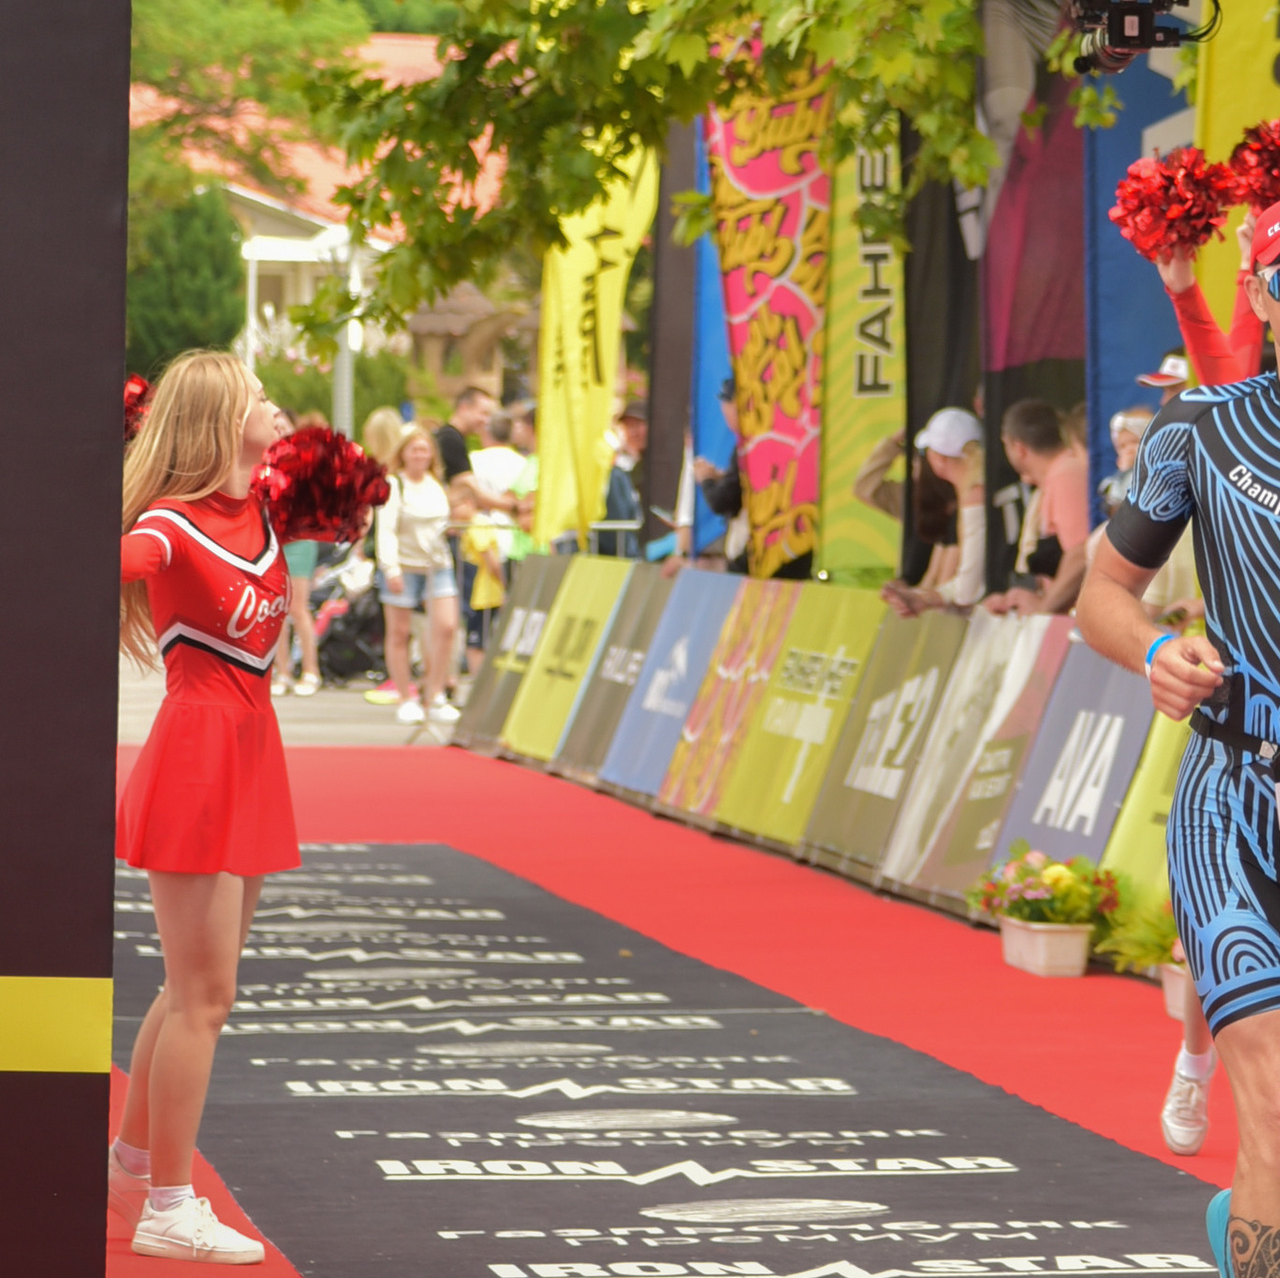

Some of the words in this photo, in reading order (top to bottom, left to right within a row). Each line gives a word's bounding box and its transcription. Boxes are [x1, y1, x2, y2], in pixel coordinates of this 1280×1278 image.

[285, 1078, 509, 1093] IRON
[618, 1077, 856, 1092] STAR
[375, 1159, 629, 1175] IRON
[748, 1157, 1018, 1172] STAR
[487, 1260, 775, 1278] IRON
[912, 1253, 1217, 1273] STAR
